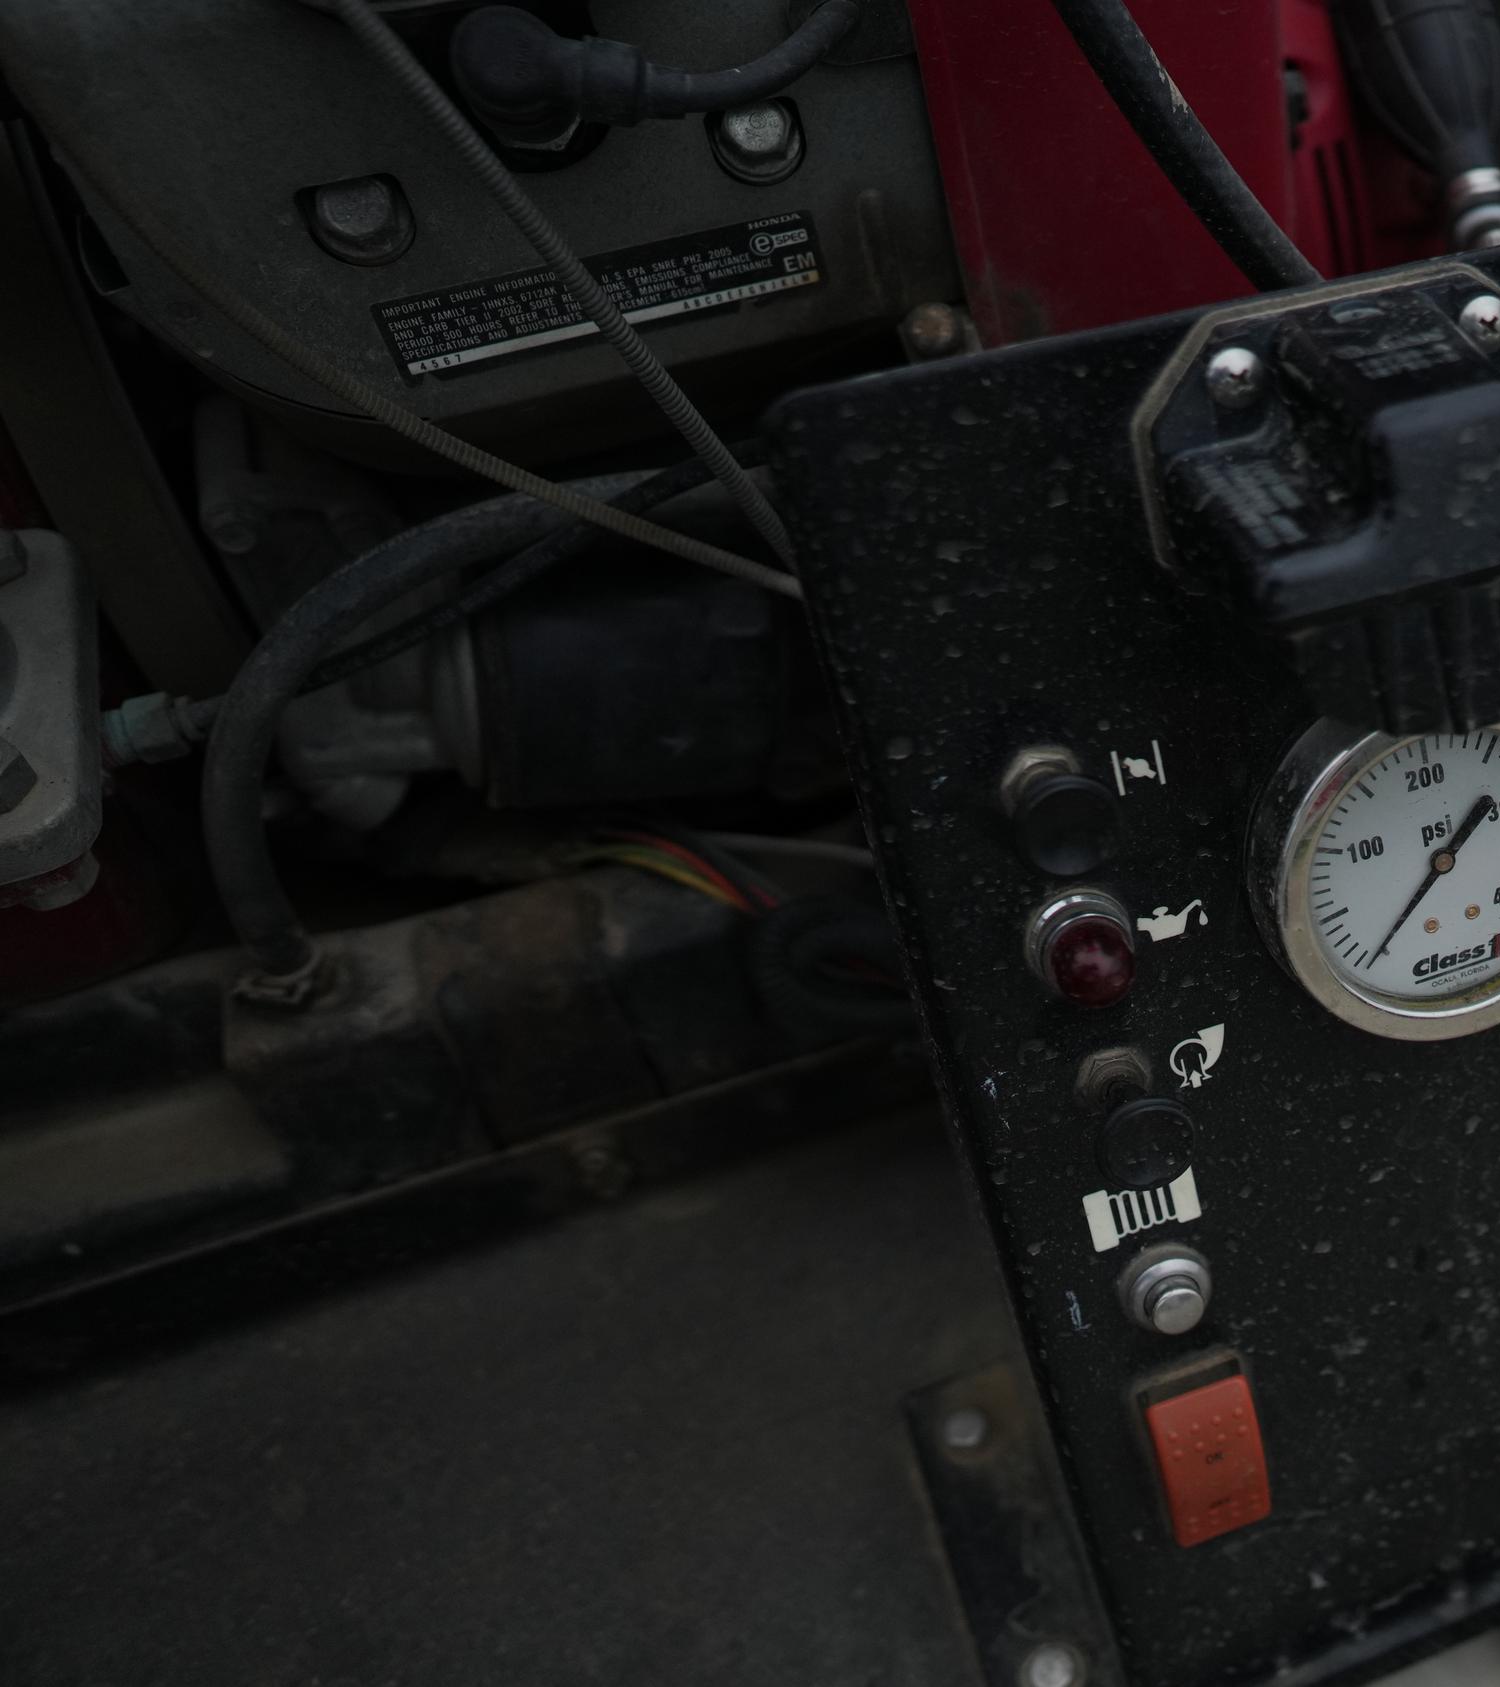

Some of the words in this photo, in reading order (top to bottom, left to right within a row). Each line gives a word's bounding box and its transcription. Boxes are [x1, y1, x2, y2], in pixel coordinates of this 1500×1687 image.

[747, 213, 801, 230] HONDA
[775, 231, 807, 245] SPEC
[783, 251, 817, 272] EM
[382, 297, 441, 318] IMPORTANT
[449, 287, 487, 303] ENGINE
[494, 271, 558, 294] INFORMATIO
[388, 315, 425, 332] ENGINE
[431, 306, 466, 321] FAMILY
[627, 266, 646, 278] EPA
[708, 246, 732, 260] 2005
[393, 329, 414, 342] AND
[421, 321, 449, 336] CARB
[455, 314, 478, 328] TIER
[498, 304, 523, 318] 2002
[635, 267, 687, 286] EMISSIONS
[692, 252, 751, 274] COMPLIANCE
[469, 320, 502, 335] HOURS
[508, 311, 539, 326] REFER
[546, 306, 559, 317] TO
[638, 280, 678, 296] MANUAL
[684, 274, 703, 286] FOR
[708, 257, 774, 280] MAINTENANCE
[401, 335, 481, 361] SPECIFICATIONS
[488, 329, 508, 341] AND
[515, 312, 583, 336] ADJUSTMENTS
[619, 293, 661, 310] ACEMENT
[1404, 763, 1445, 792] 200
[1421, 814, 1453, 847] psi
[1346, 835, 1384, 864] 100
[1460, 964, 1490, 978] FLORIDA
